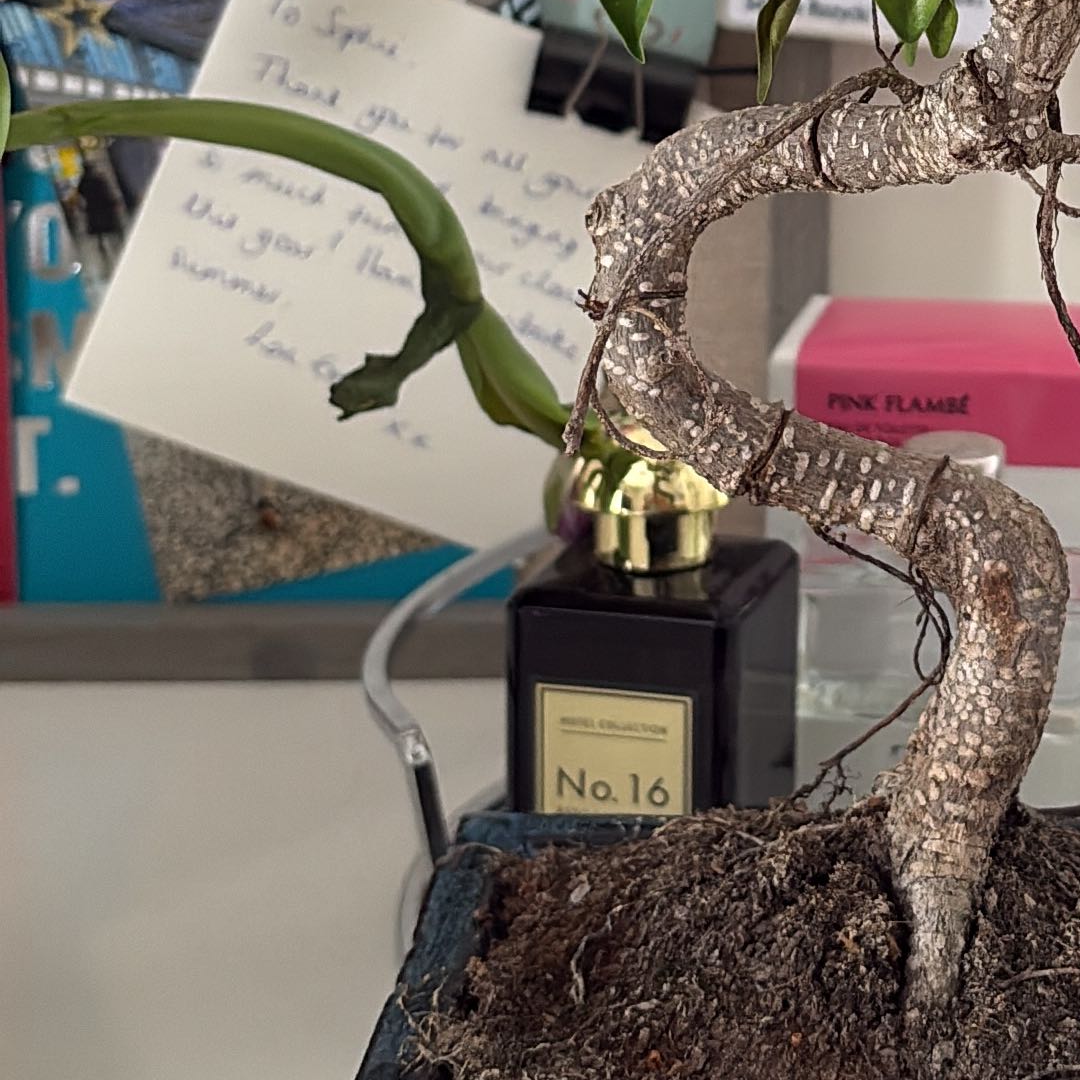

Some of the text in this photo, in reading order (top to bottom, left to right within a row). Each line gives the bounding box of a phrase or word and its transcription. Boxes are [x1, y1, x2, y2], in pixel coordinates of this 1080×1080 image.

[828, 393, 876, 411] PINK
[556, 766, 670, 807] No. 16
